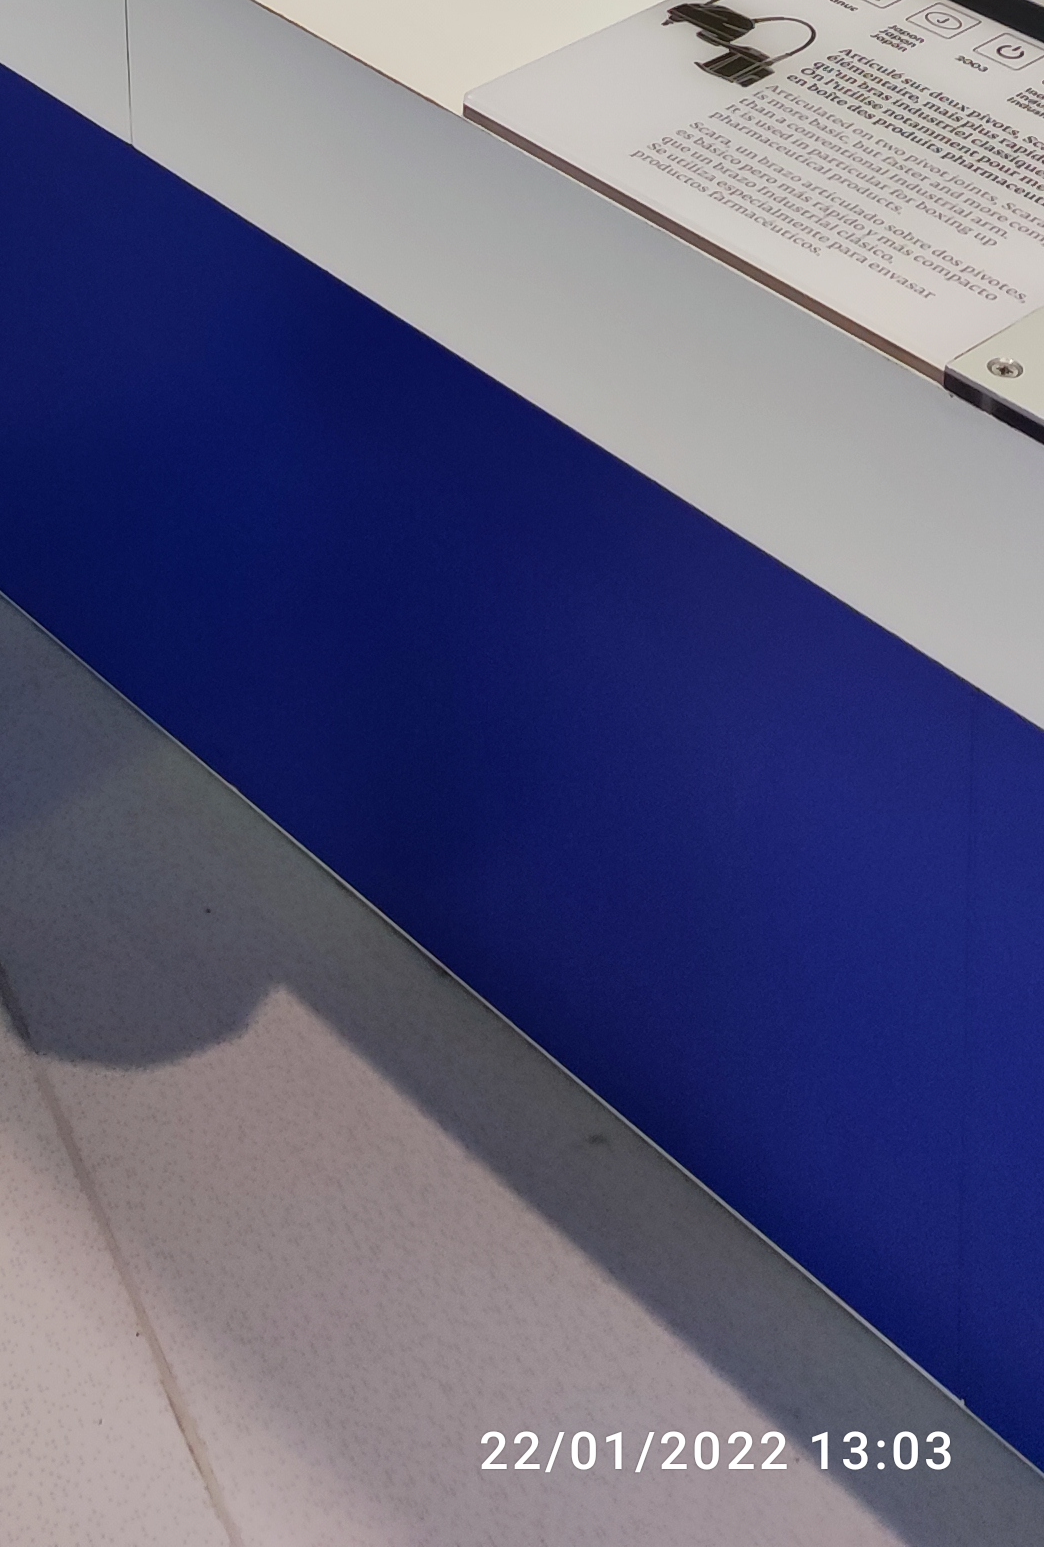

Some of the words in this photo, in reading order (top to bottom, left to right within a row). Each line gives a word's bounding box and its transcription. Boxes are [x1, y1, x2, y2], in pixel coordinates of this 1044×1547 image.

[886, 23, 926, 45] Japon
[763, 84, 856, 131] Articulated
[851, 127, 875, 142] on
[873, 137, 907, 157] two
[901, 153, 950, 179] pivot
[943, 173, 999, 207] joints,
[785, 73, 809, 88] en
[805, 81, 849, 107] boîte
[845, 103, 877, 121] des
[870, 116, 944, 155] produits
[799, 66, 826, 83] On
[822, 77, 885, 111] l'utilise
[880, 107, 981, 159] notamment
[974, 154, 1022, 178] pour
[812, 60, 859, 86] qu'un
[856, 79, 894, 102] bras
[890, 97, 975, 141] industriel
[825, 53, 921, 105] élémentaire,
[921, 100, 965, 124] mais
[958, 119, 1001, 141] plus
[997, 136, 1044, 163] rapid
[837, 47, 906, 81] Articulé
[899, 77, 932, 94] sur
[927, 90, 972, 114] deux
[964, 108, 1021, 141] pivots,
[627, 148, 710, 194] productos
[706, 189, 823, 258] farmacéuticos.
[660, 135, 693, 154] que
[689, 149, 715, 166] un
[711, 160, 758, 189] brazo
[835, 228, 895, 266] clásico.
[688, 120, 733, 150] Scara,
[733, 144, 759, 161] un
[756, 154, 803, 183] brazo
[800, 180, 886, 227] articulado
[882, 223, 933, 252] sobre
[930, 248, 965, 268] dos
[957, 264, 1028, 305] pivotes,
[707, 110, 834, 177] pharmaceutical
[825, 172, 904, 216] products.
[723, 102, 742, 116] It
[738, 111, 757, 123] is
[753, 118, 796, 142] used
[789, 137, 811, 151] in
[804, 147, 890, 192] particular
[887, 187, 917, 205] for
[913, 199, 976, 236] boxing
[972, 231, 999, 248] up
[737, 97, 777, 120] than
[773, 115, 788, 126] a
[785, 121, 892, 177] conventional
[969, 215, 1009, 241] arm.
[751, 89, 770, 102] is
[765, 97, 810, 123] more
[807, 116, 851, 146] basic,
[851, 139, 884, 159] but
[880, 155, 932, 183] faster
[927, 180, 966, 201] and
[961, 196, 1010, 223] more
[645, 141, 669, 156] Se
[665, 152, 718, 184] utiliza
[715, 179, 832, 244] especialmente
[824, 240, 870, 265] para
[866, 261, 937, 300] envasar
[674, 128, 696, 142] es
[691, 135, 743, 166] básico
[736, 162, 779, 185] pero
[776, 181, 814, 204] más
[810, 200, 867, 232] rápido
[861, 227, 880, 239] y
[875, 234, 916, 258] más
[912, 254, 999, 302] compacto
